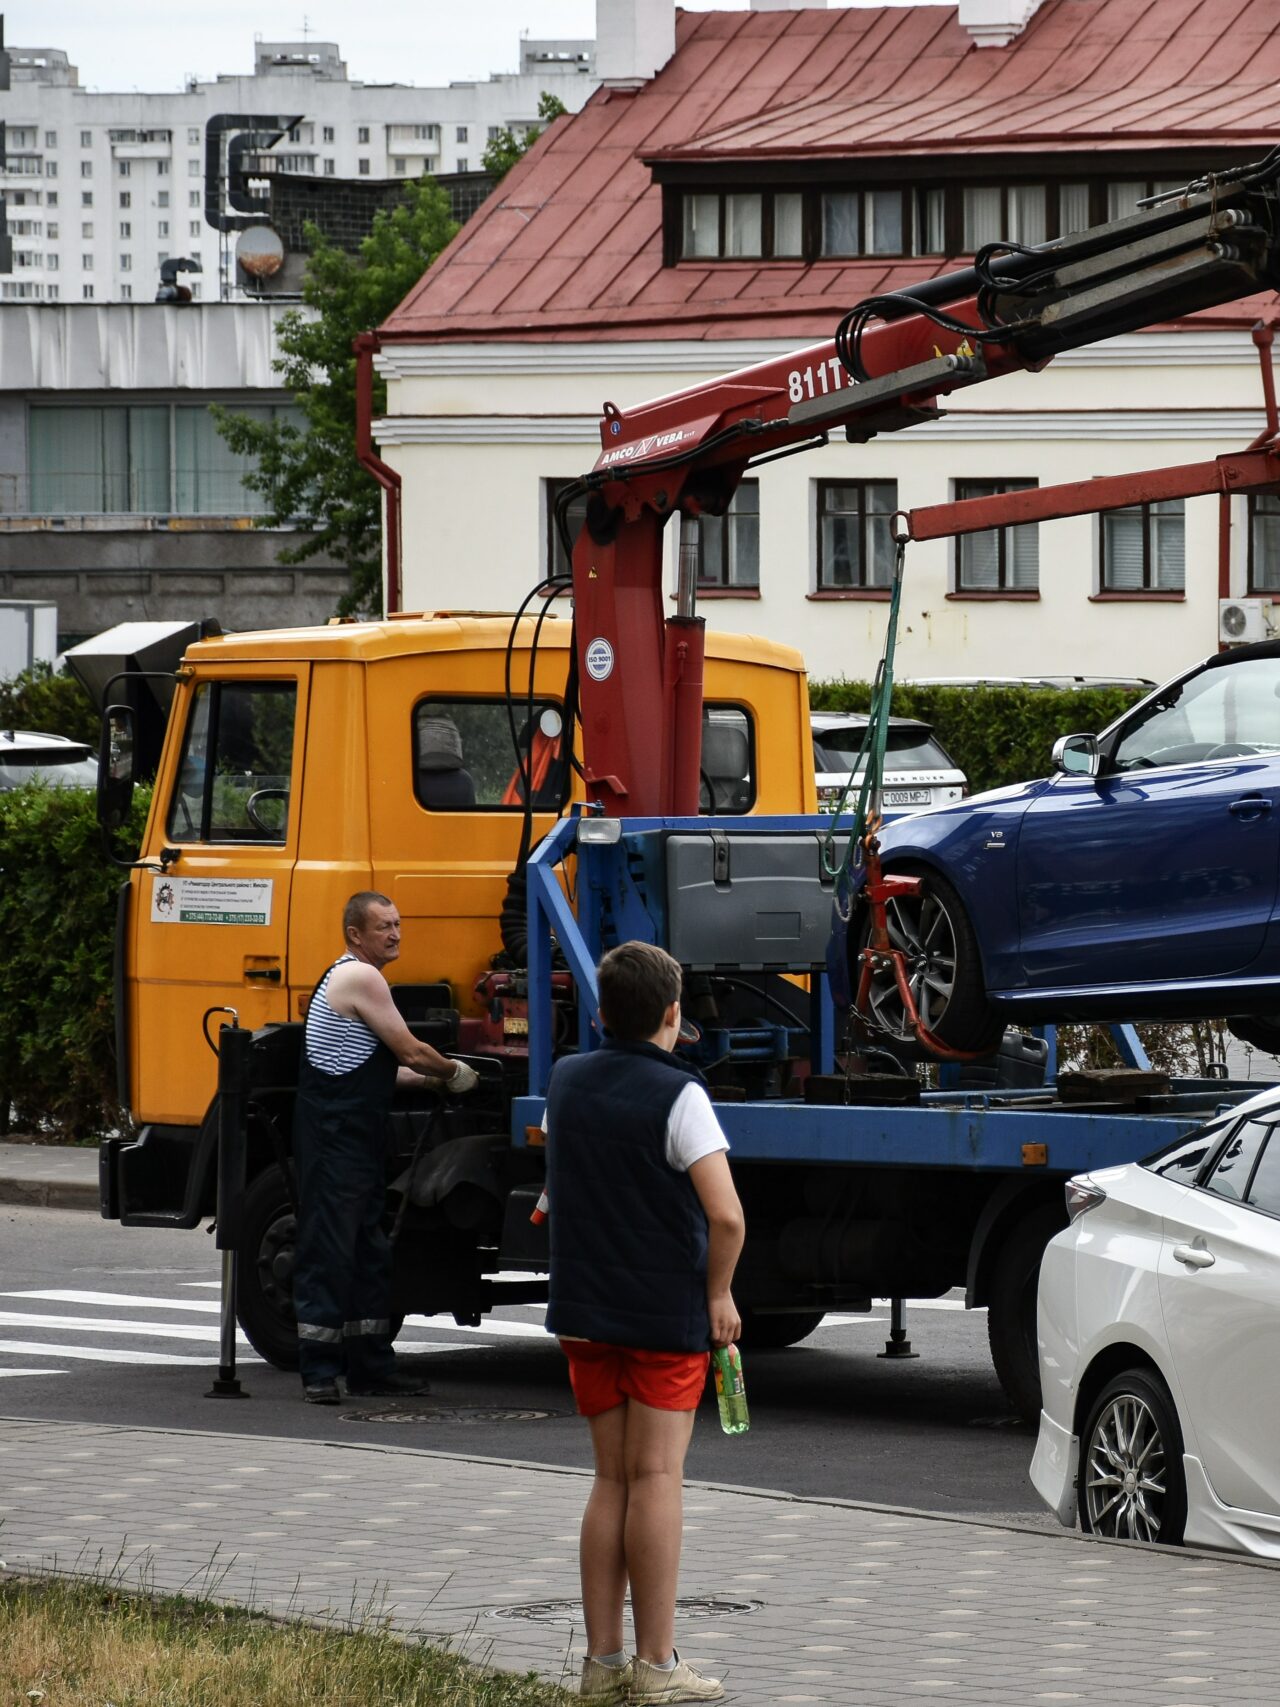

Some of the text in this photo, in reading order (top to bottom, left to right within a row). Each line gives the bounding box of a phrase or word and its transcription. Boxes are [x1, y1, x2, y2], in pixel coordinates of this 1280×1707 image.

[788, 356, 842, 403] 811T
[601, 446, 634, 465] AMCO
[656, 430, 683, 447] VEBA
[890, 790, 929, 803] 0009 MP-7
